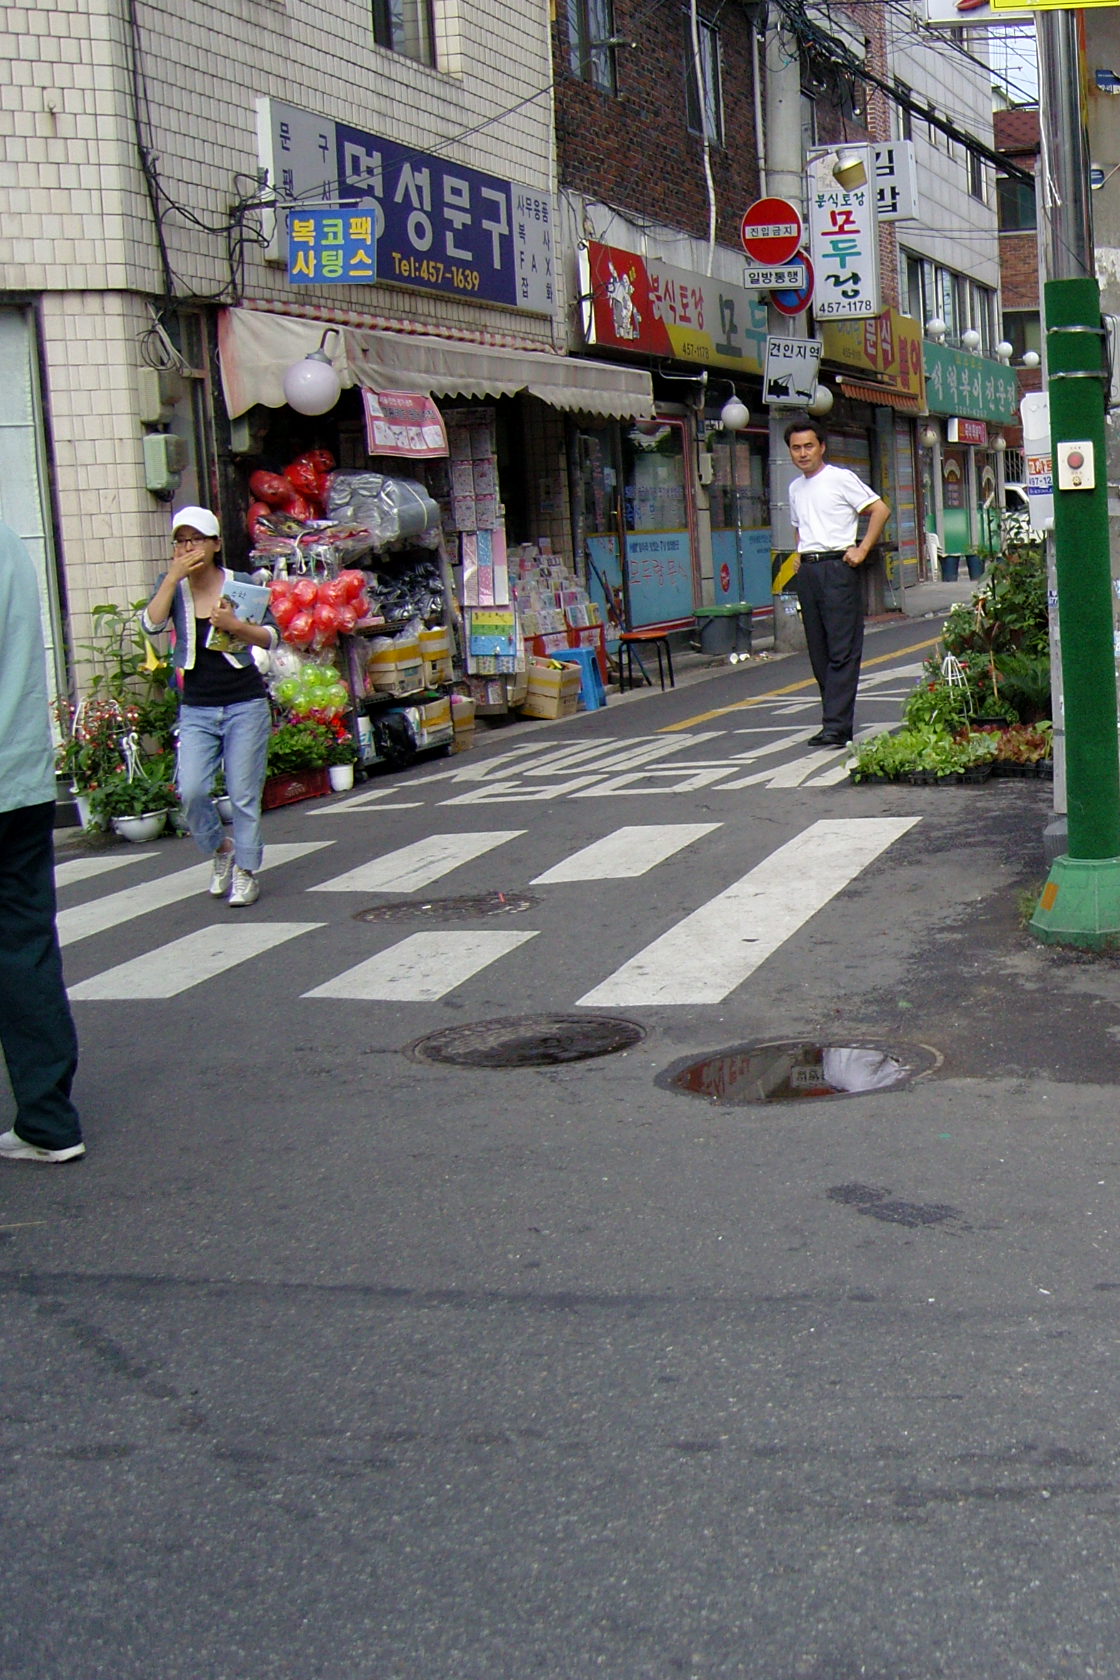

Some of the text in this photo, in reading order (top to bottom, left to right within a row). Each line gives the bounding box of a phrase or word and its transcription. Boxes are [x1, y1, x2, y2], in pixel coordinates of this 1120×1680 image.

[344, 141, 511, 271] 명성문구
[815, 192, 865, 209] 분식토랑
[750, 225, 794, 238] 진입금지
[292, 219, 317, 278] 복사
[320, 219, 345, 278] 코팅
[348, 217, 373, 277] 팩스
[392, 251, 480, 292] Tel:457-1639
[748, 271, 799, 285] 일방통행
[819, 300, 872, 313] 457-1178
[770, 341, 821, 361] 견인지역
